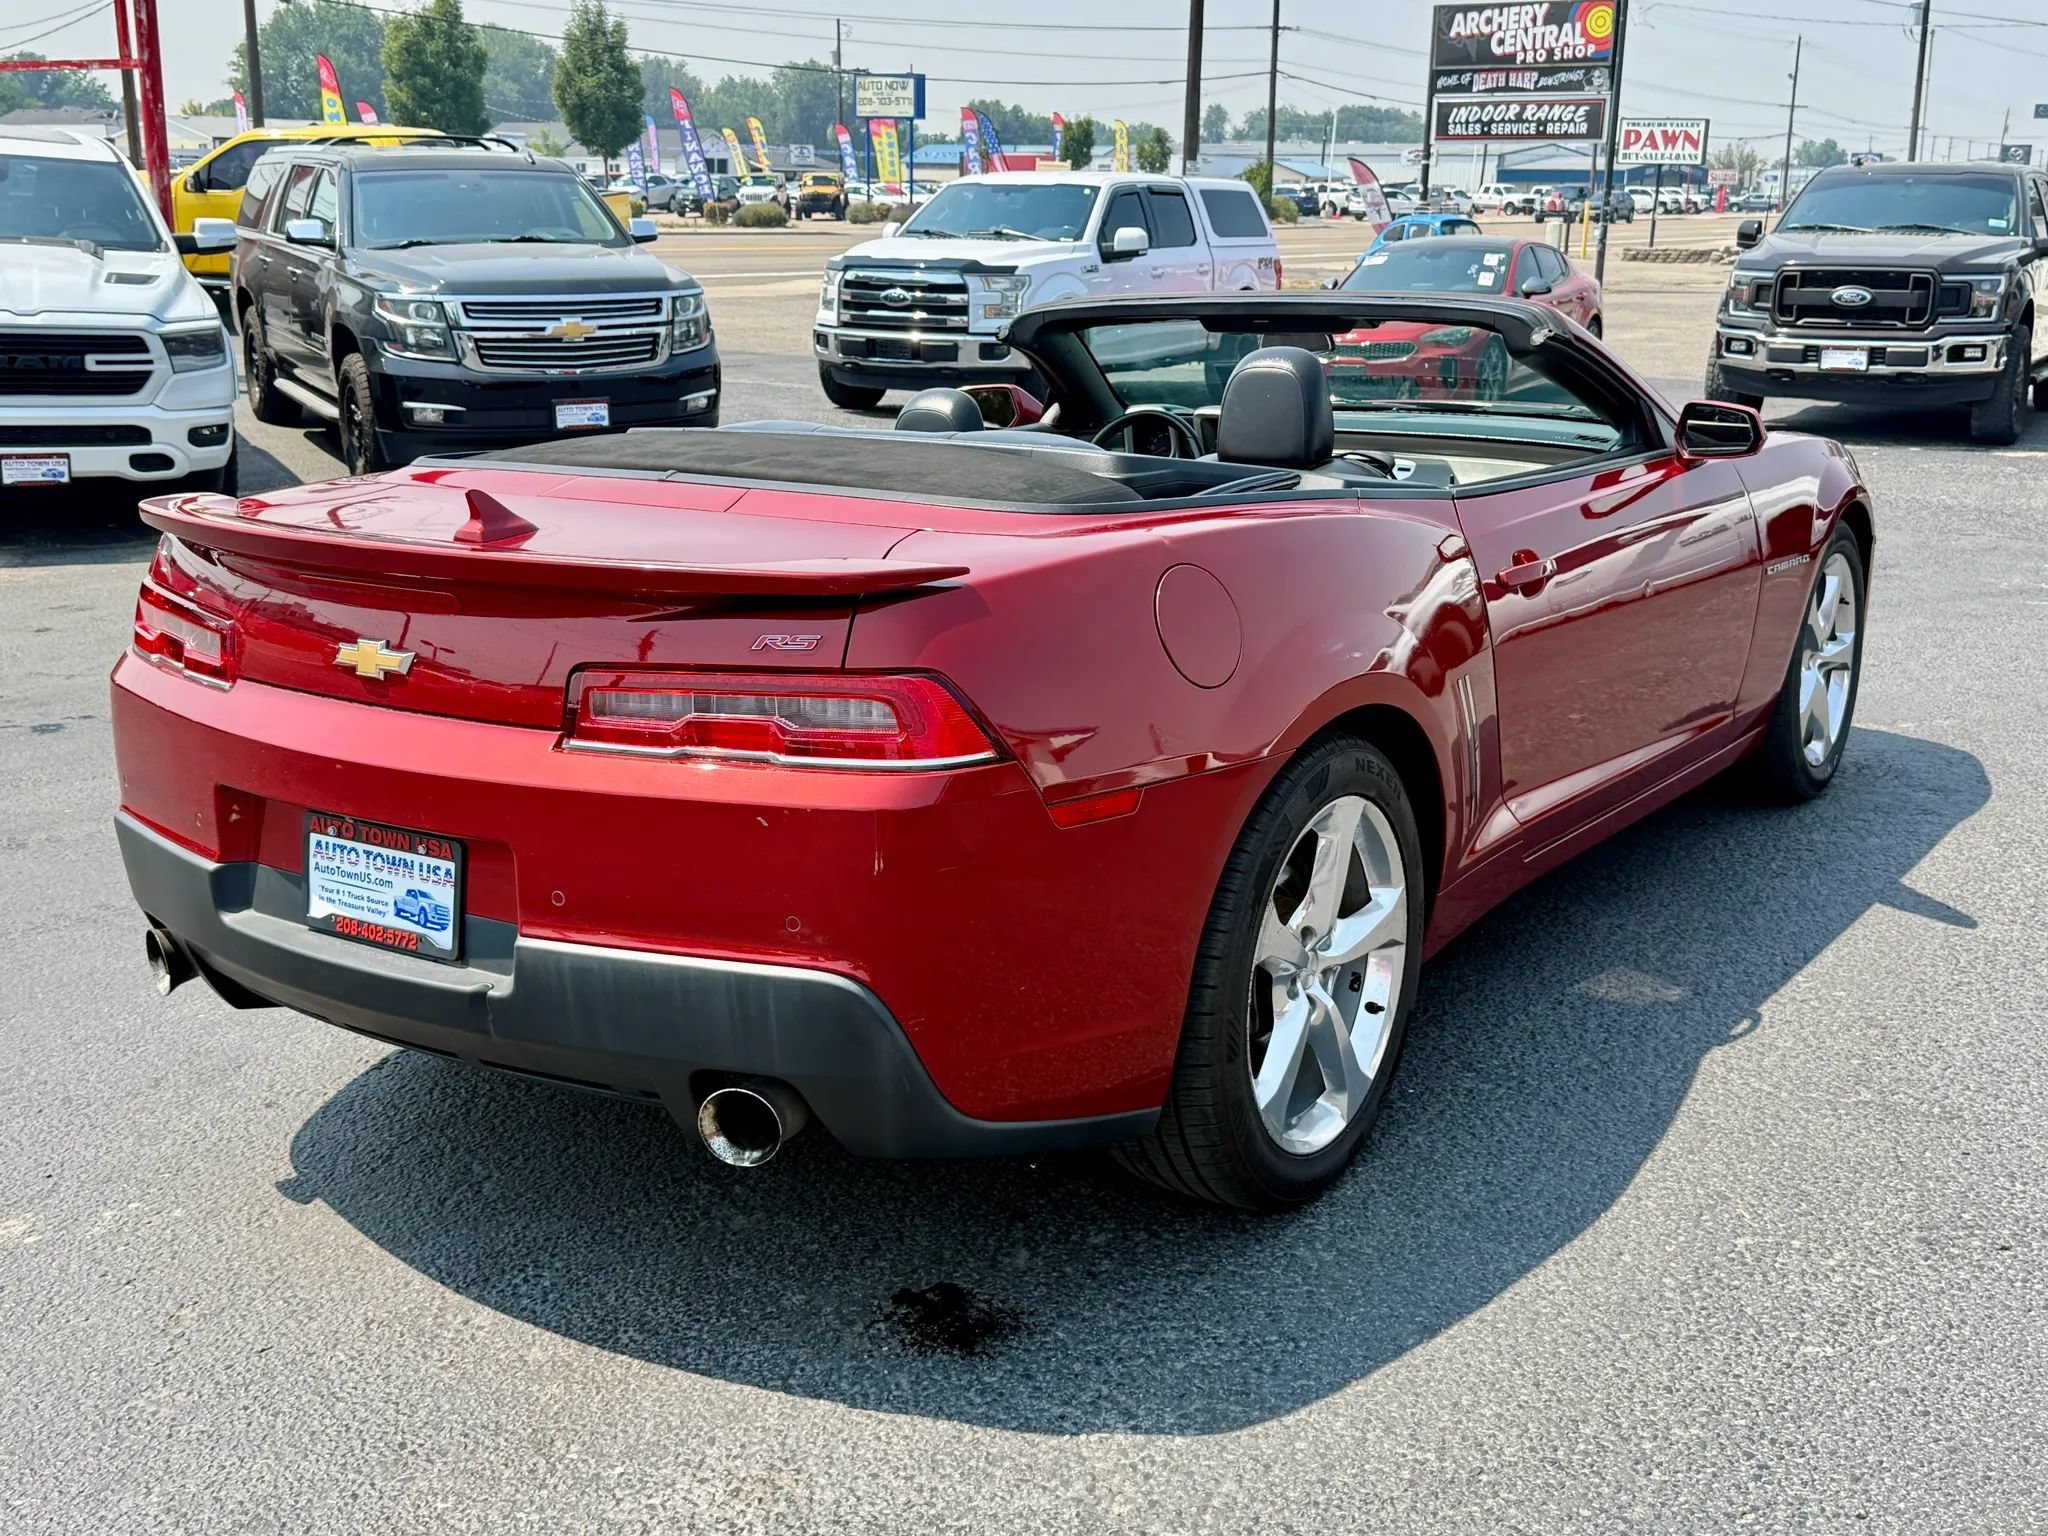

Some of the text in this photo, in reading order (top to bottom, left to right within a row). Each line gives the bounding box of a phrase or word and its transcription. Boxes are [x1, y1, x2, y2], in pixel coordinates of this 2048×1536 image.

[1449, 3, 1550, 39] ARCHERY
[1490, 22, 1586, 56] CENTRAL
[1516, 44, 1596, 64] PRO SHOP
[858, 80, 909, 91] AUTO NOW
[1437, 69, 1585, 92] HOME OF DEATH HARP BOWSTRINGS
[1448, 104, 1590, 123] INDOOR RANGE
[1448, 122, 1588, 135] SALES SERVICE REPAIR
[1622, 129, 1701, 151] PAWN
[0, 355, 83, 369] AM
[751, 635, 821, 649] RS
[1355, 758, 1400, 800] NEXEN
[310, 816, 453, 859] AUTO TOWN USA
[313, 839, 455, 888] AUTO TOWN USA
[314, 862, 393, 889] AutoTownUS.com
[326, 896, 336, 904] the
[338, 898, 365, 911] Treasure
[347, 891, 365, 901] Truck
[367, 896, 389, 907] Source
